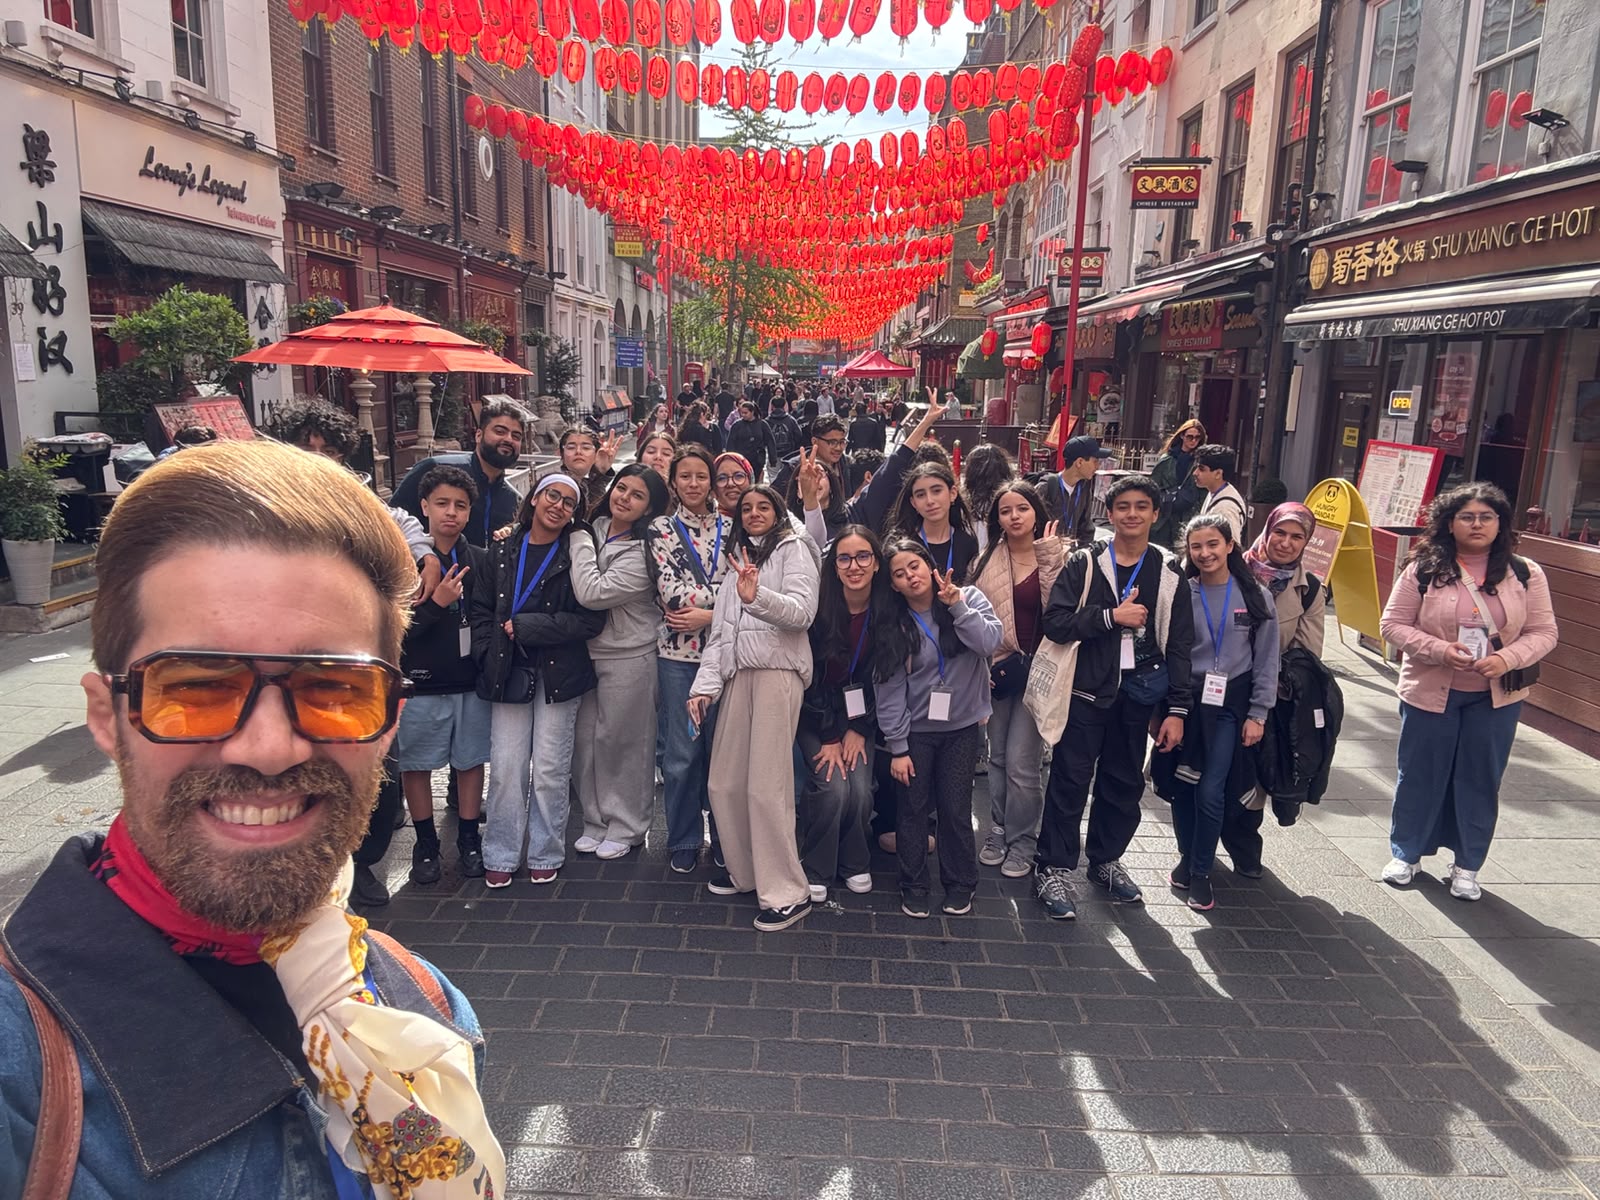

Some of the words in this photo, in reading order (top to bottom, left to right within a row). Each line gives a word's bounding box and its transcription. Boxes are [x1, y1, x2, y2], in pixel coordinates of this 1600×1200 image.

[139, 146, 196, 196] Leong's
[197, 165, 247, 206] Legend
[1430, 232, 1462, 259] SHU
[1464, 221, 1517, 254] XIANG
[1521, 215, 1546, 243] GE
[1550, 206, 1595, 239] HOT
[11, 302, 24, 315] 39
[1392, 318, 1411, 331] SHU
[1410, 315, 1442, 331] XIANG
[1443, 314, 1459, 329] GE
[1458, 312, 1482, 328] HOT
[1482, 309, 1507, 326] POT
[1316, 503, 1338, 512] HUNGRY
